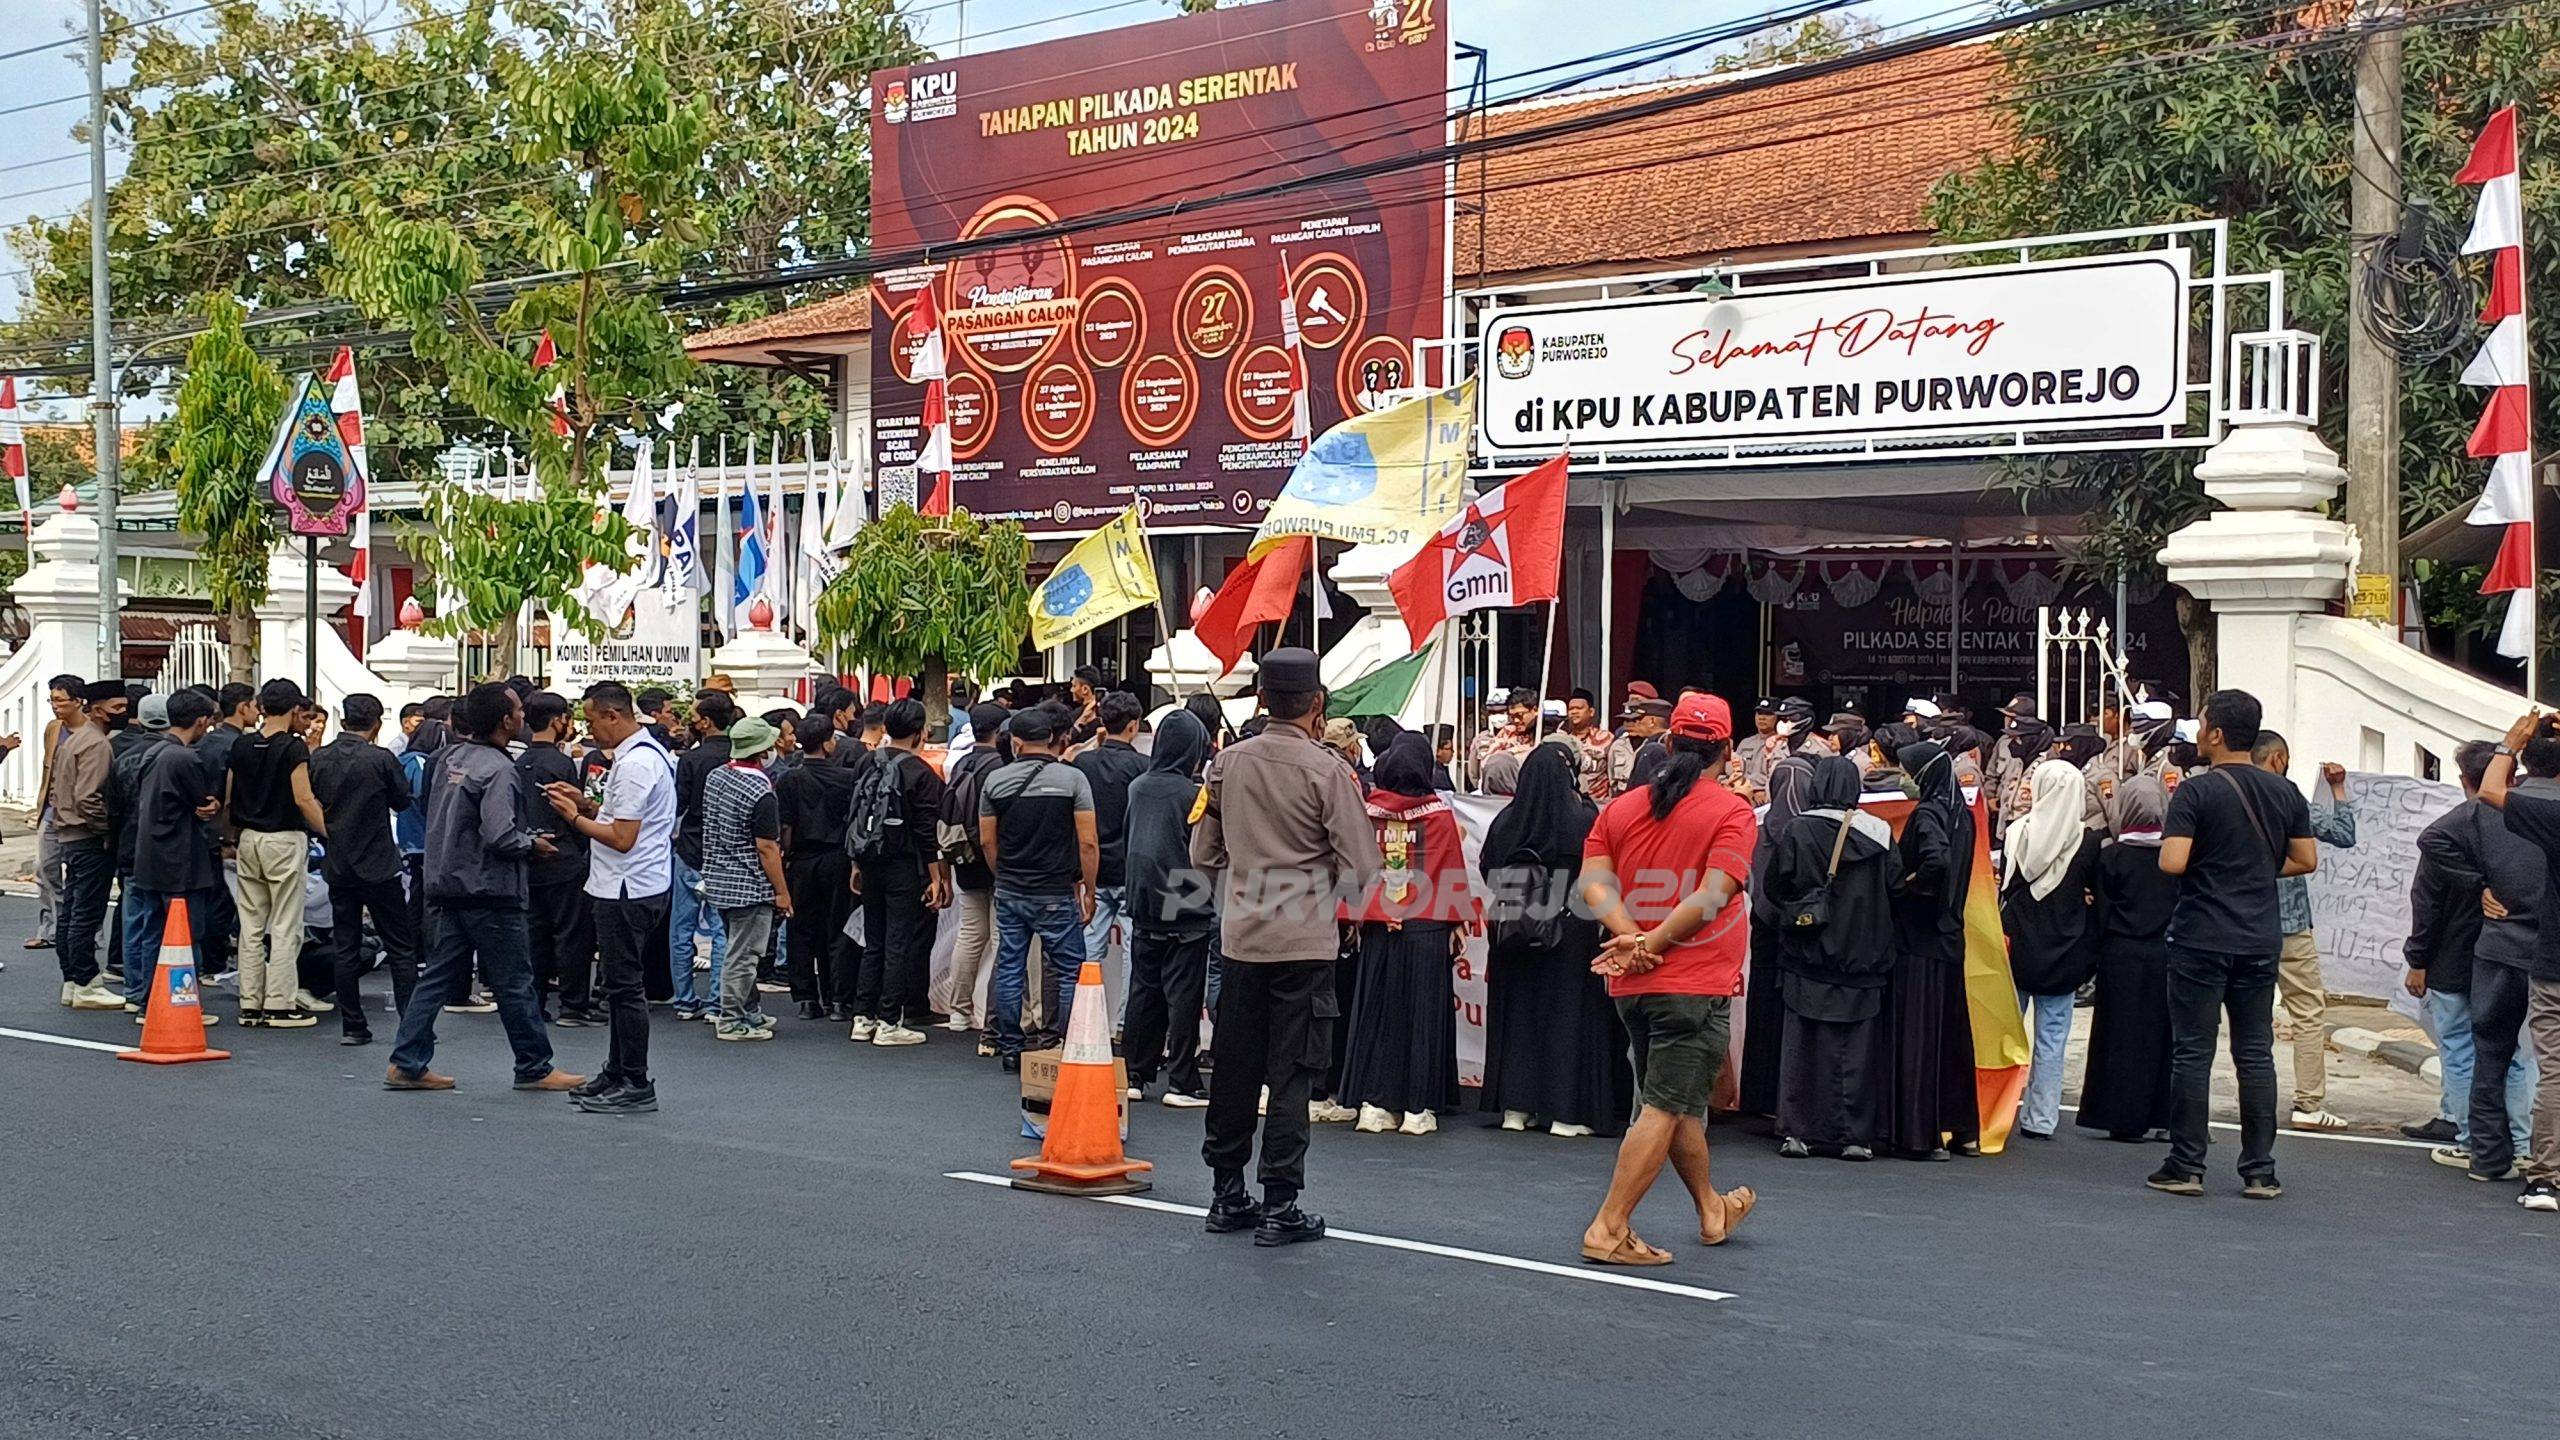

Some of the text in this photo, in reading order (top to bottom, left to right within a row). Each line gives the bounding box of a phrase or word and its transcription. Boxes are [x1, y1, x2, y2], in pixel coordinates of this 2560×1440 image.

[911, 71, 957, 101] KPU
[979, 62, 1299, 138] TAHAPAN PILKADA SERENTAK
[1067, 111, 1200, 157] TAHUN 2024
[1301, 216, 1350, 231] PENETAPAN
[1180, 228, 1243, 244] PELAKSANAAN
[1270, 223, 1381, 245] PASANGAN CALON TERPILIH
[1167, 236, 1256, 257] PEMUNGUTAN SUARA
[1080, 250, 1153, 267] PASANGAN CALON
[967, 285, 1055, 313] Pendaftaran
[1200, 291, 1228, 324] 27
[947, 304, 1077, 332] PASANGAN CALON
[1542, 333, 1605, 349] KABUPATEN
[1670, 305, 2005, 376] Selamat Datang
[1541, 347, 1608, 363] PURWOREJO
[1515, 363, 2141, 434] di KPU KABUPATEN PURWOREJO
[876, 416, 921, 428] SYARAT DAN
[886, 440, 910, 451] SCAN
[1222, 443, 1282, 454] PENGHITUNGAN
[879, 450, 917, 464] QR CODE
[1035, 456, 1080, 468] PENELITIAN
[1129, 450, 1188, 462] PELAKSANAAN
[1218, 453, 1235, 463] DAN
[1236, 450, 1290, 462] REKAPITULASI
[1019, 465, 1097, 479] PERSYARATAN CALON
[1136, 460, 1181, 472] KAMPANYE
[1222, 460, 1282, 471] PENGHITUNGAN
[1196, 481, 1214, 491] 2024
[1843, 632, 1920, 650] PILKADA
[596, 645, 653, 662] PEMILIHAN
[655, 646, 690, 663] UMUM
[621, 665, 673, 676] PURWOREJO
[1375, 828, 1417, 844] IMM
